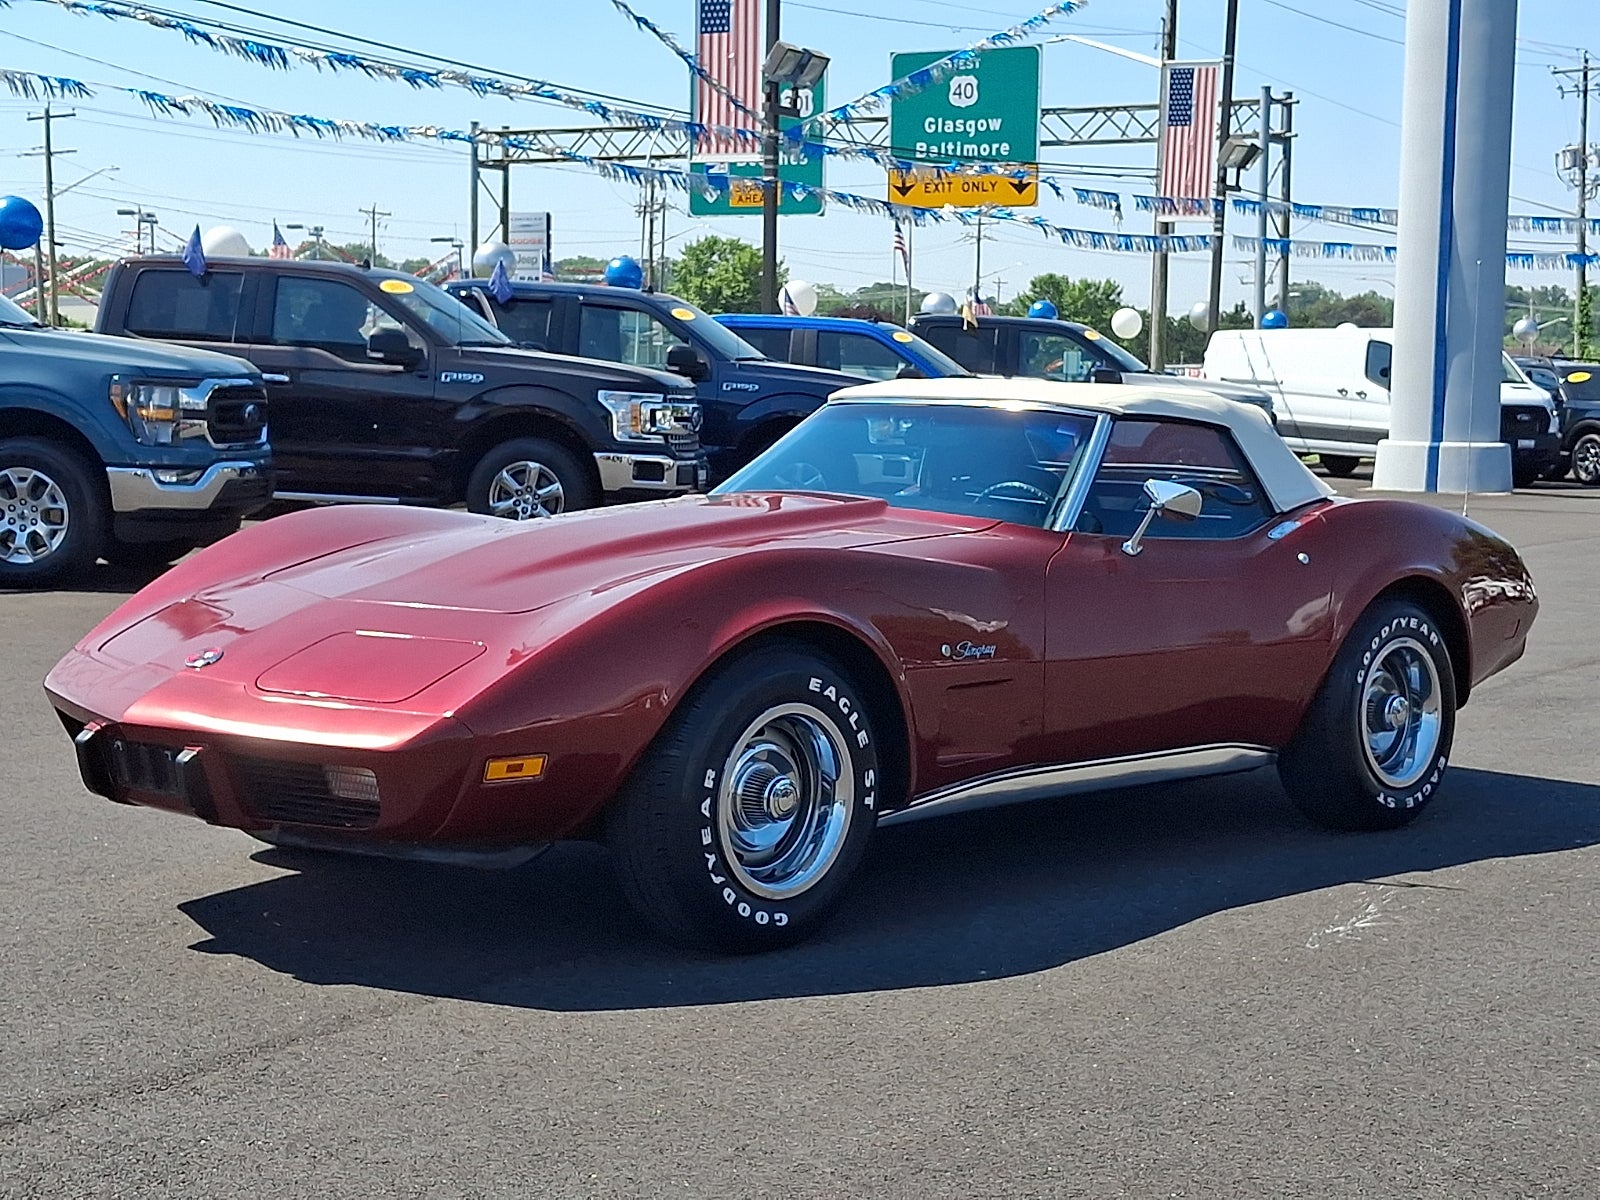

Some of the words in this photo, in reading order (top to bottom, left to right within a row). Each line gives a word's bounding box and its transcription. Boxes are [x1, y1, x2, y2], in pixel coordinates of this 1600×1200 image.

[952, 82, 974, 100] 40
[924, 117, 1002, 138] Glasgow
[915, 141, 1010, 158] Baltimore
[924, 182, 953, 194] EXIT
[962, 181, 998, 193] ONLY
[737, 194, 765, 204] AHE
[517, 254, 538, 266] Jeep
[952, 641, 997, 660] Stingray
[1357, 616, 1440, 684] GOODYEAR
[808, 677, 869, 749] EAGLE
[864, 769, 876, 810] ST
[1406, 755, 1447, 808] EAGLE
[1376, 791, 1397, 809] ST
[700, 768, 789, 927] GOODYEAR
